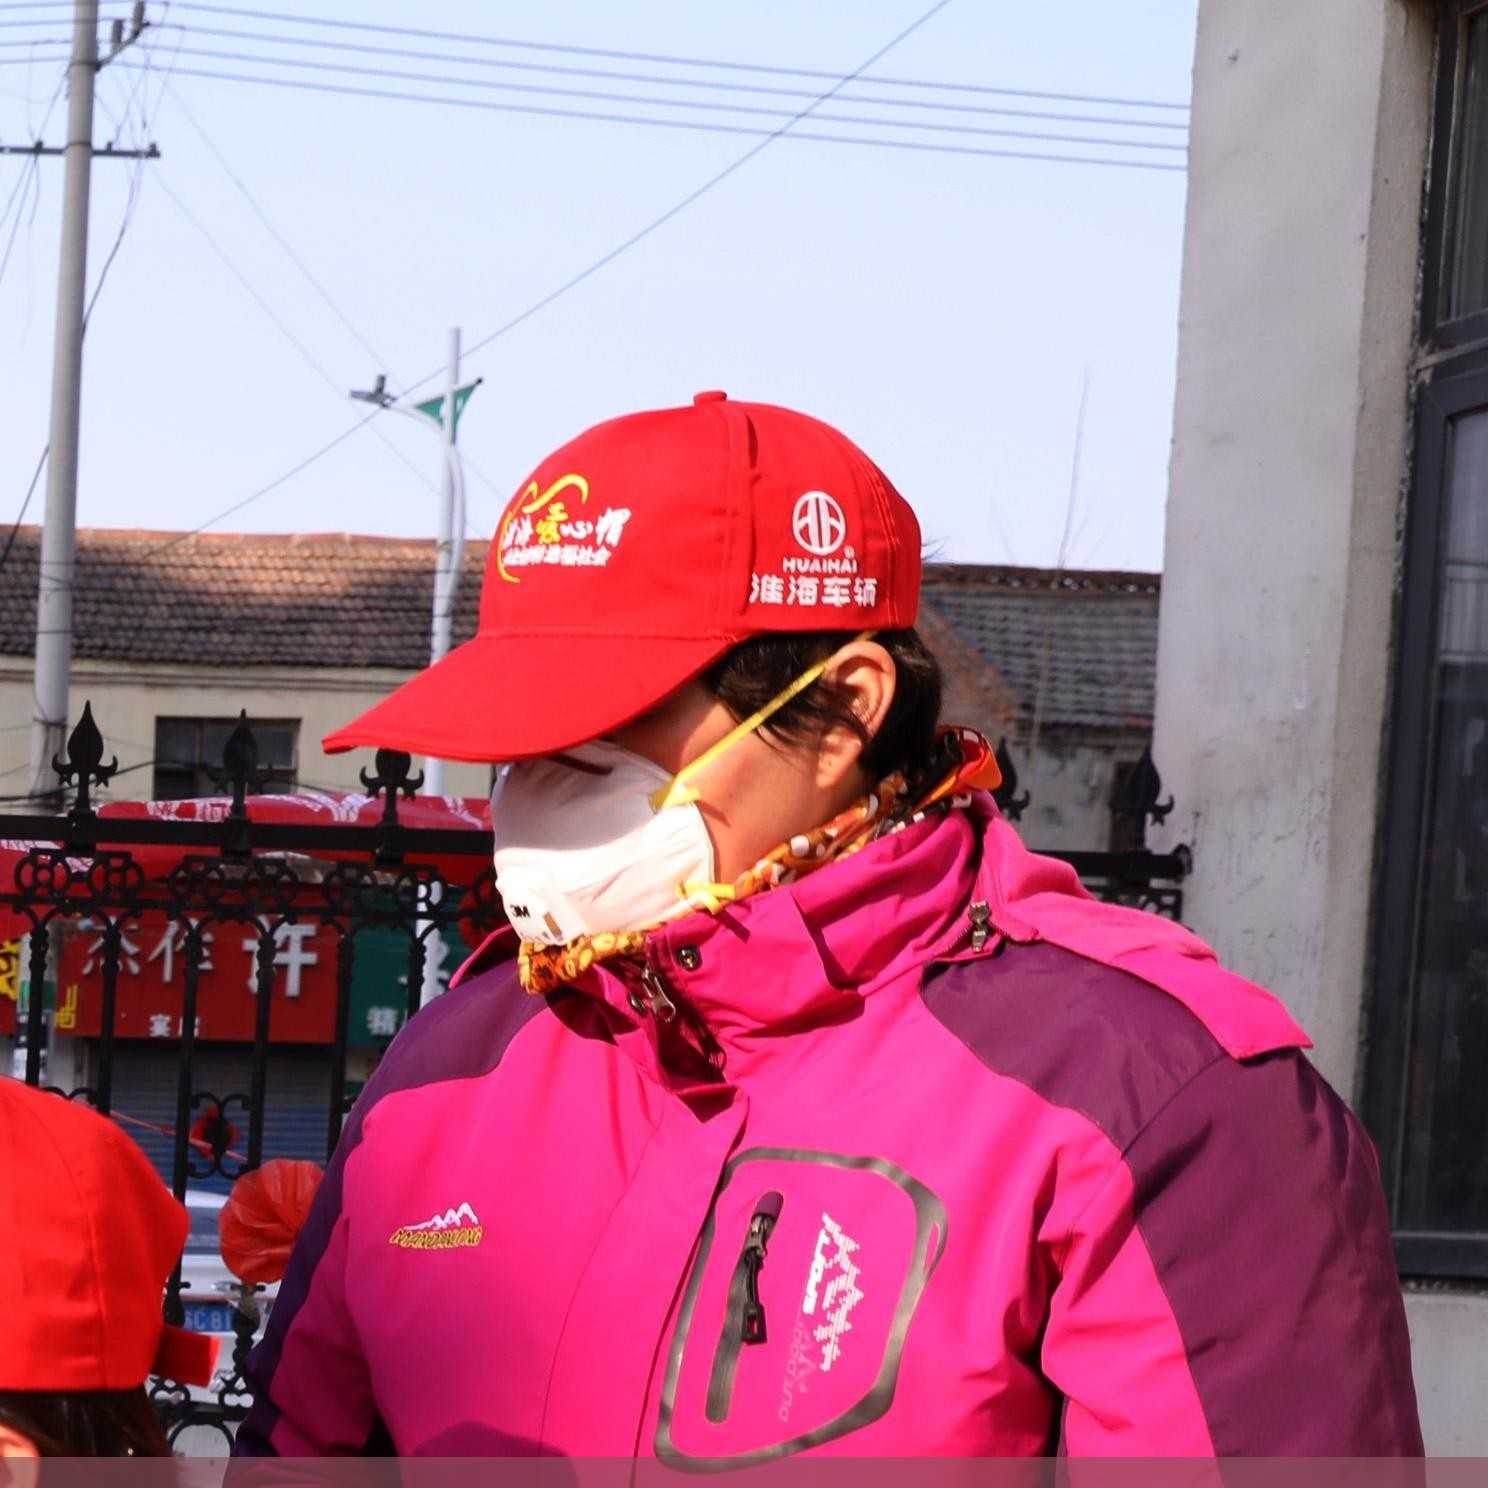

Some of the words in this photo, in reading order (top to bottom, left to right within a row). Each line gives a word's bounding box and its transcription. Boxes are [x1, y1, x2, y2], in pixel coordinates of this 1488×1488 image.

[782, 557, 858, 574] HUAIHAI
[749, 572, 877, 608] 淮海车辆
